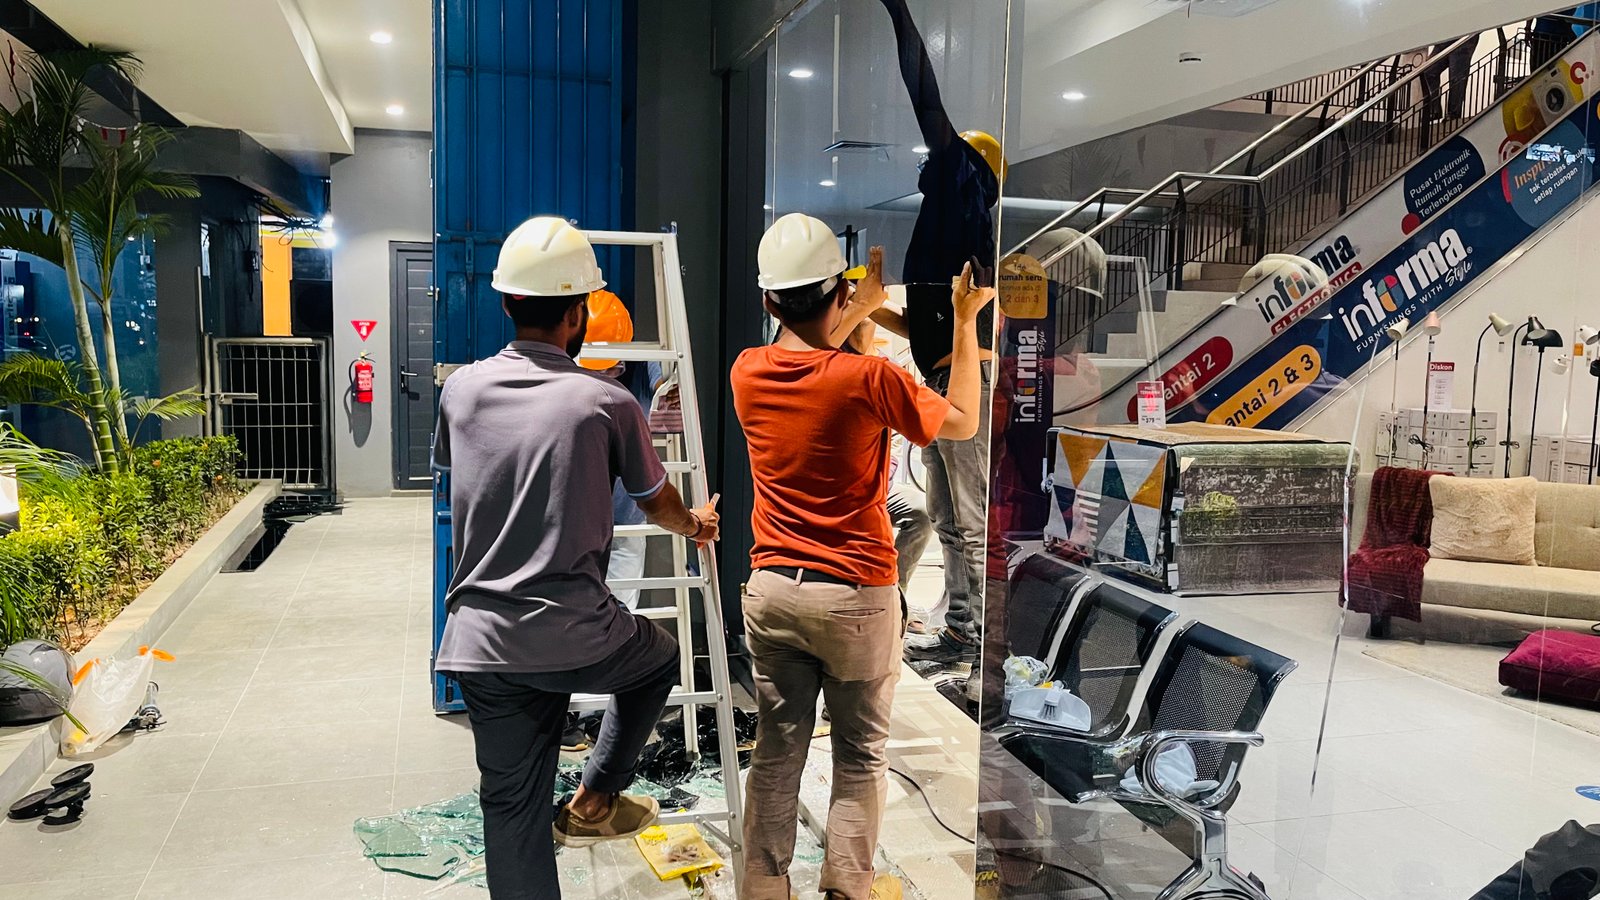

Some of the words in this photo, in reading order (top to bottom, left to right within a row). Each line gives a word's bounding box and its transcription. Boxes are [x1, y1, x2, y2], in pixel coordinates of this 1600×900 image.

[1410, 177, 1433, 198] Pusat
[1433, 149, 1470, 180] Elektronik
[1414, 184, 1441, 208] Rumah
[1442, 163, 1470, 187] Tangga
[1529, 182, 1541, 194] tak
[1540, 163, 1566, 186] terbatas
[1533, 187, 1553, 205] setiap
[1553, 167, 1578, 190] ruangan
[1419, 183, 1463, 217] Terlengkap
[1339, 228, 1469, 342] informa
[1419, 284, 1443, 304] WITH
[1444, 261, 1473, 287] Style
[1013, 330, 1038, 422] informa
[1202, 352, 1216, 370] 2
[1268, 377, 1283, 396] 2
[1283, 366, 1300, 384] &
[1300, 353, 1314, 372] 3
